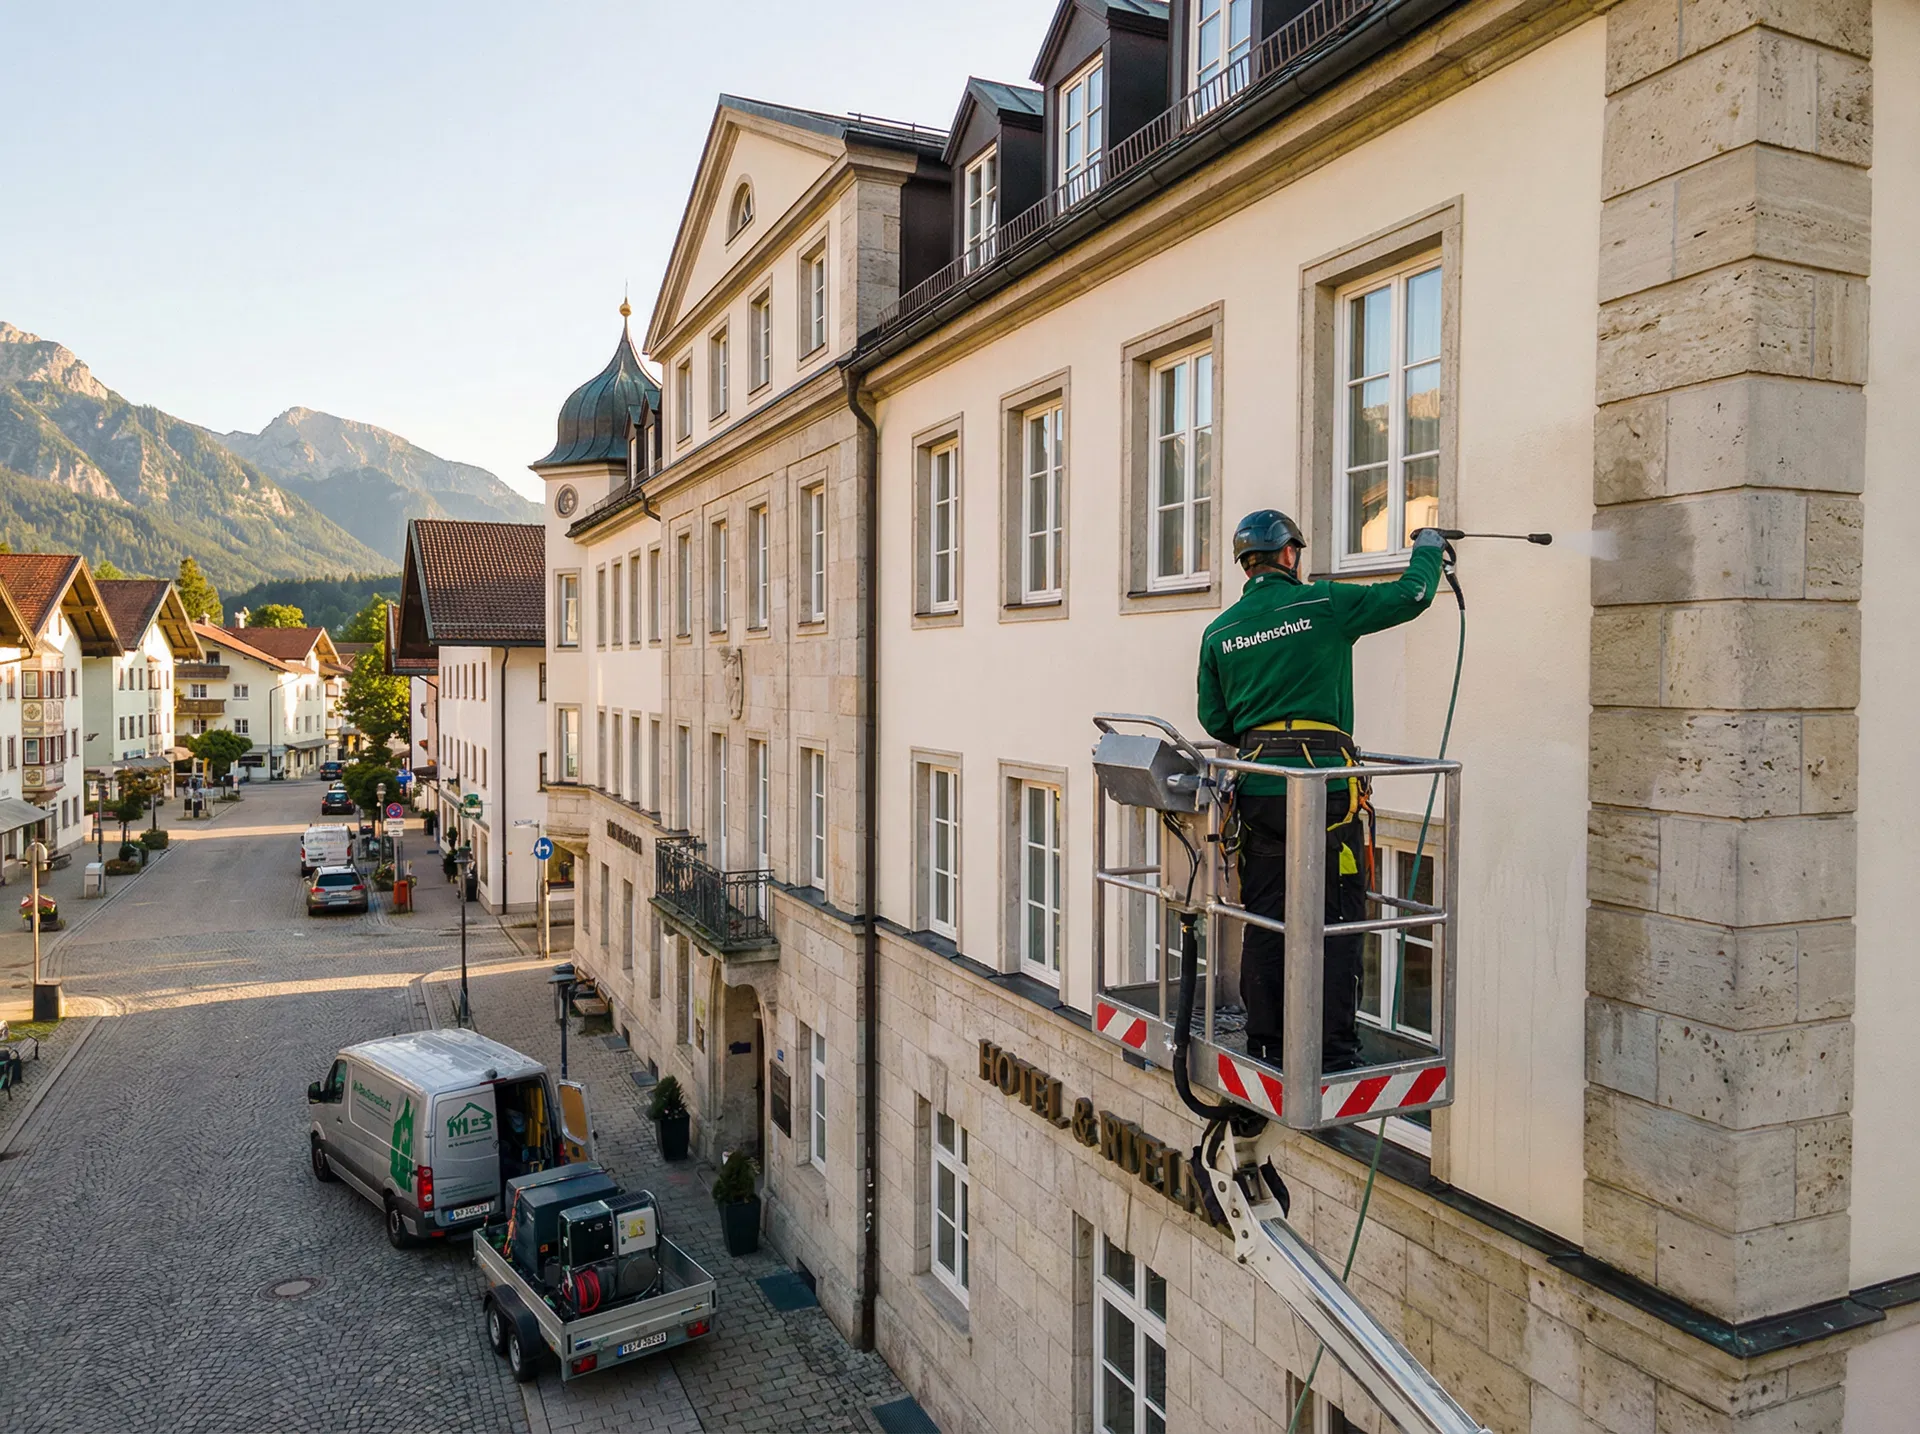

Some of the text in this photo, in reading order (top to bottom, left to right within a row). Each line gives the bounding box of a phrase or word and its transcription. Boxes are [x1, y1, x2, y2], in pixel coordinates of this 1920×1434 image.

[1222, 618, 1312, 654] M-Bautenschutz
[978, 1038, 1071, 1130] HOTEL
[1072, 1096, 1100, 1148] &
